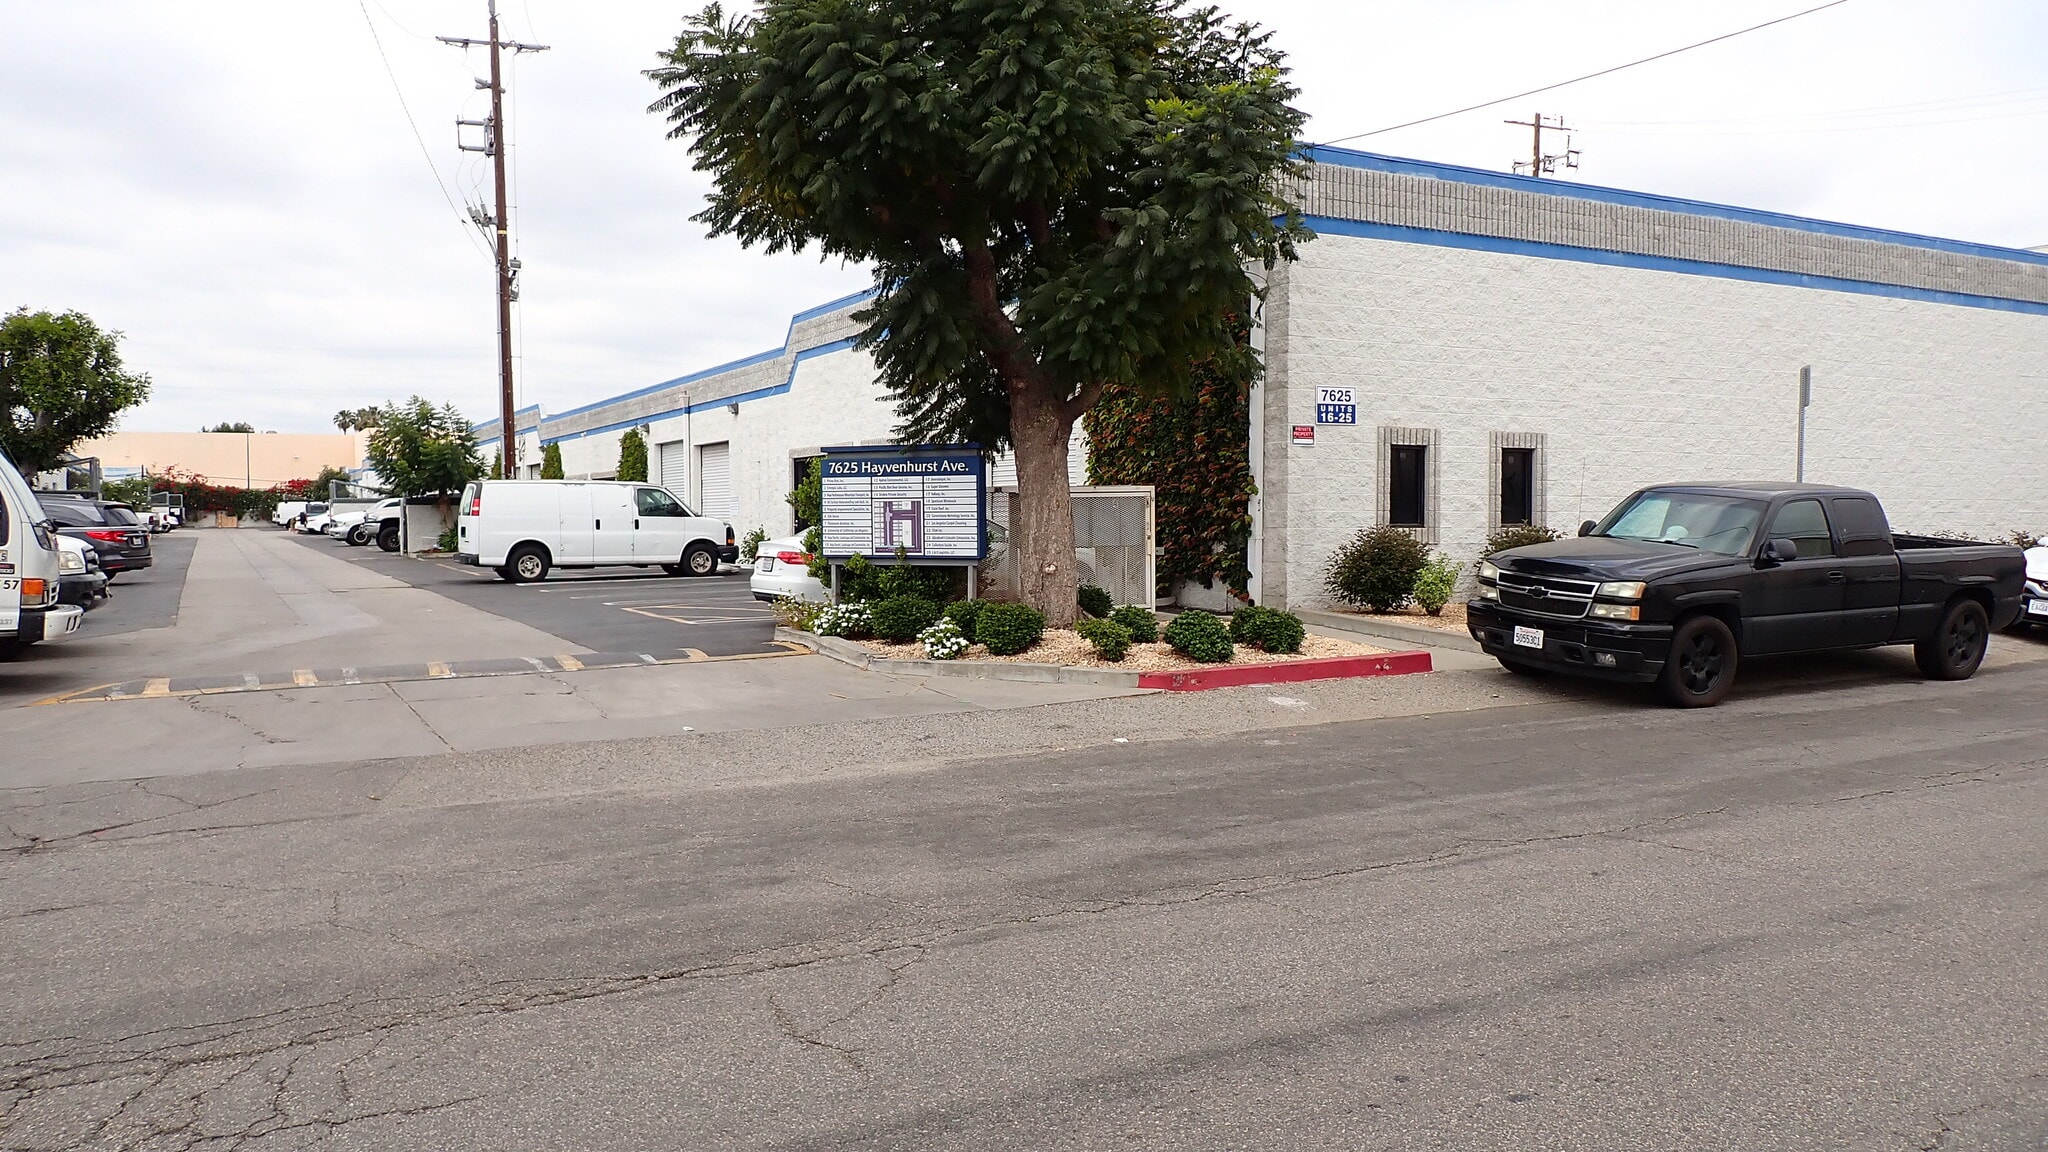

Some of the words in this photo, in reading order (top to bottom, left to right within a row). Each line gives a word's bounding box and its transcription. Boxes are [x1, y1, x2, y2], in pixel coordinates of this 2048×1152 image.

[1321, 389, 1351, 402] 7625
[1321, 412, 1352, 423] 16-25
[828, 462, 858, 474] 7625
[861, 460, 938, 475] Hayvenhurst
[941, 459, 969, 472] Ave.
